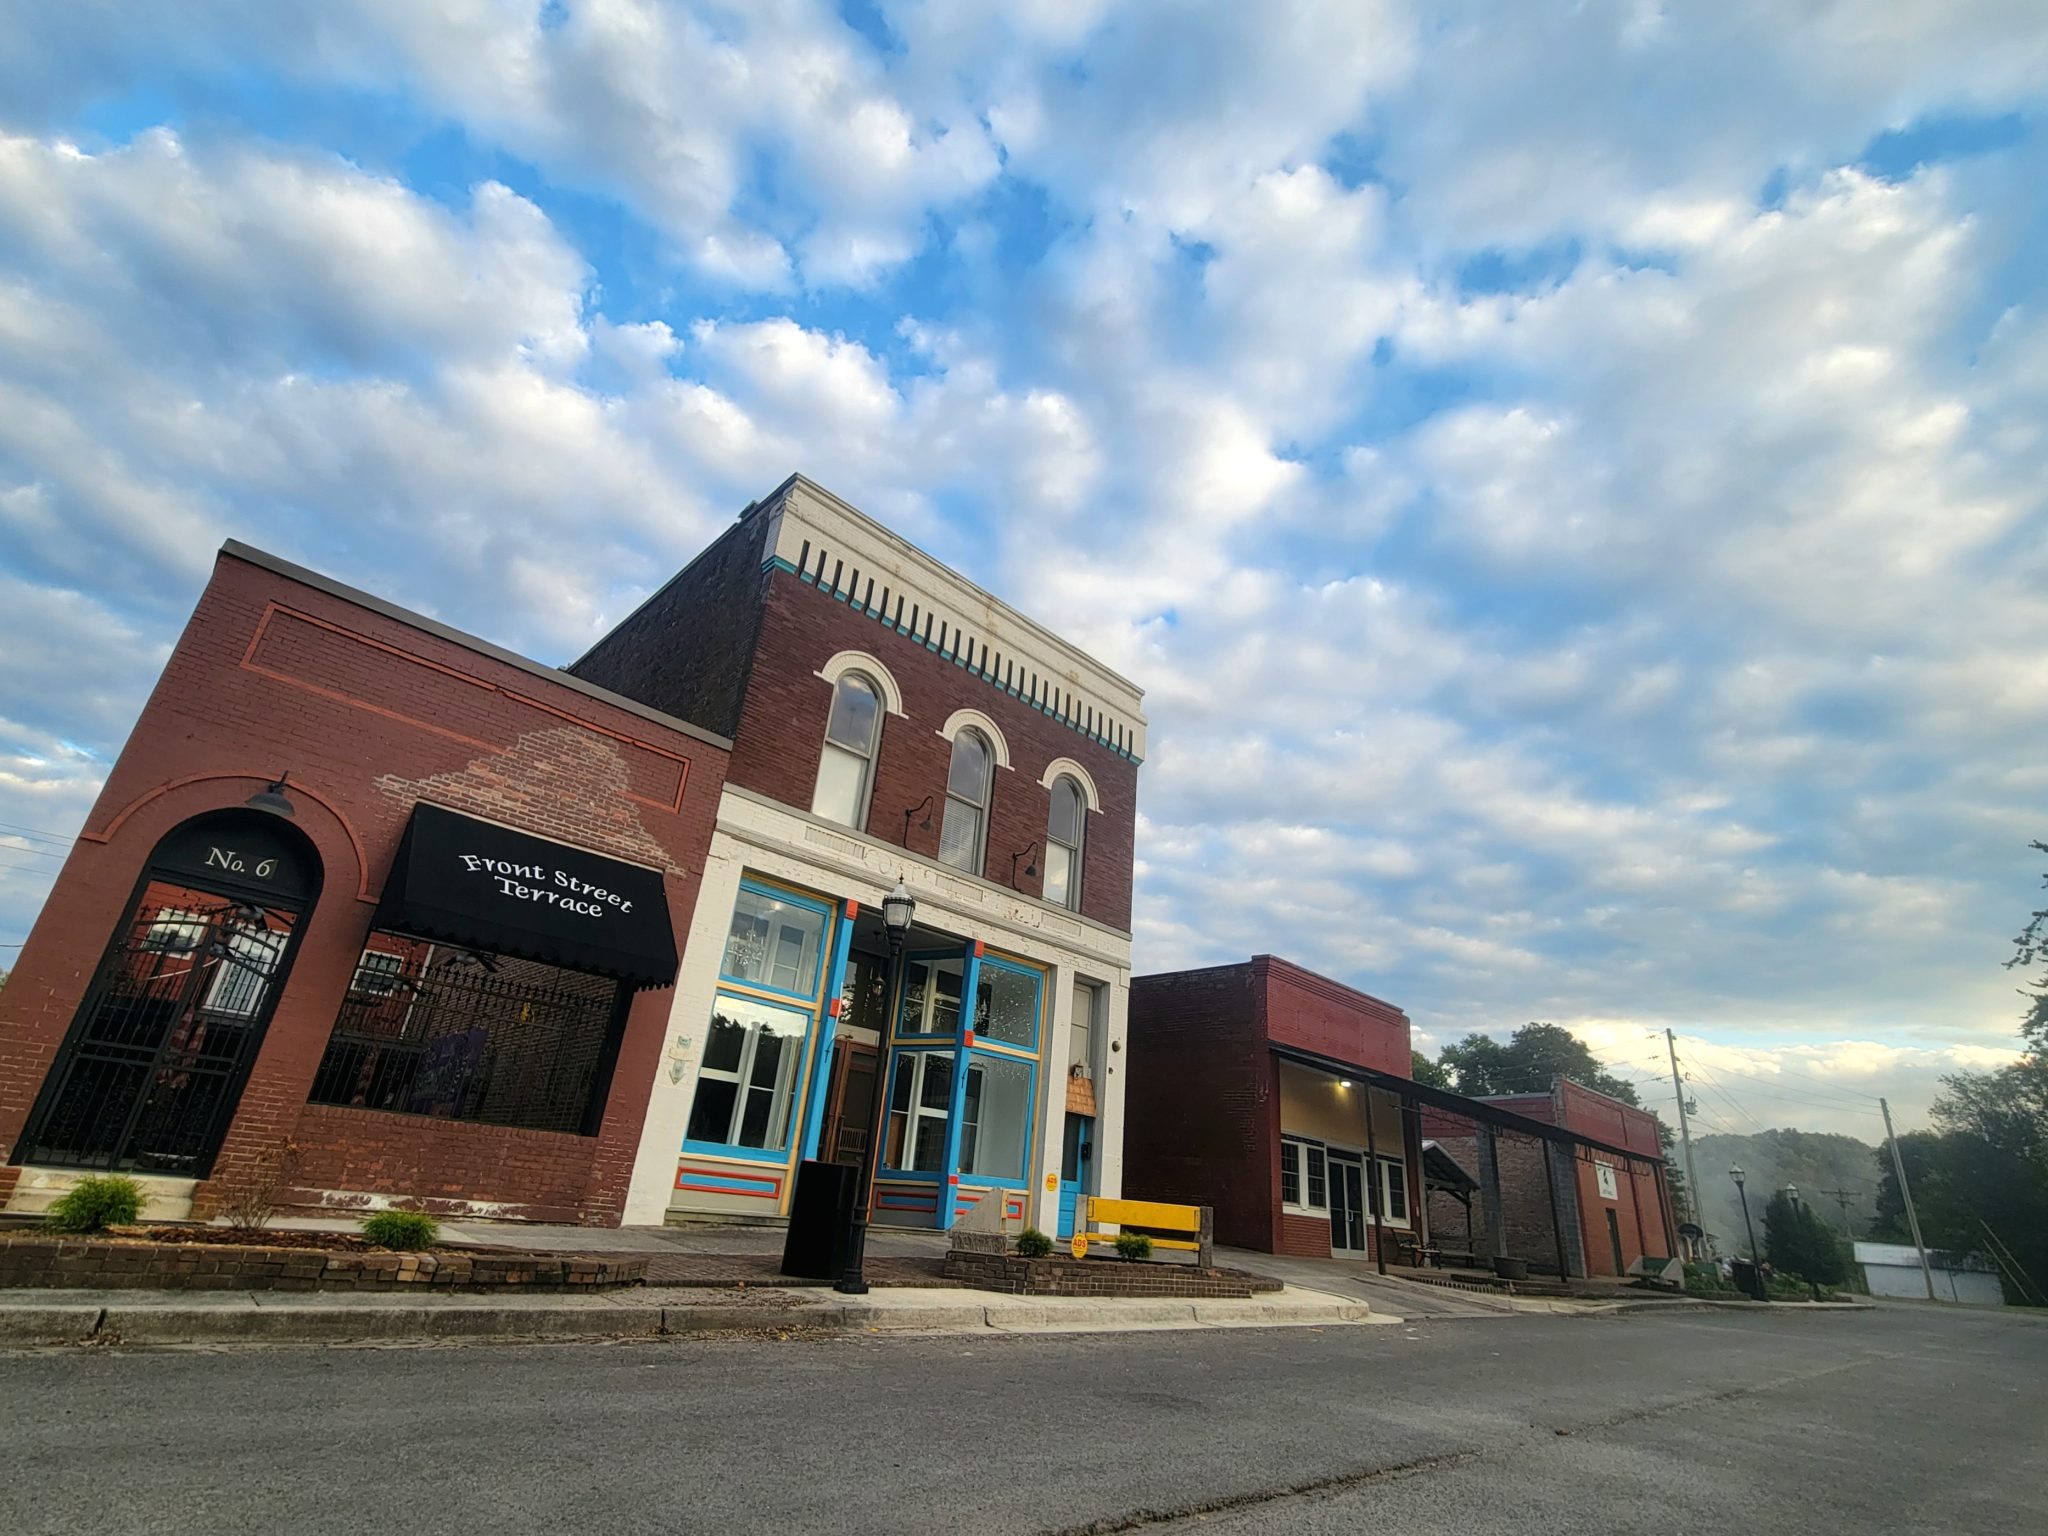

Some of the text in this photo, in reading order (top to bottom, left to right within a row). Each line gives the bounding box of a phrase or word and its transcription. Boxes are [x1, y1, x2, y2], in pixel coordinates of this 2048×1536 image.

[205, 847, 274, 877] No. 6
[459, 855, 633, 913] Front Street
[494, 876, 602, 917] Terrace
[1073, 1238, 1086, 1248] ADS
